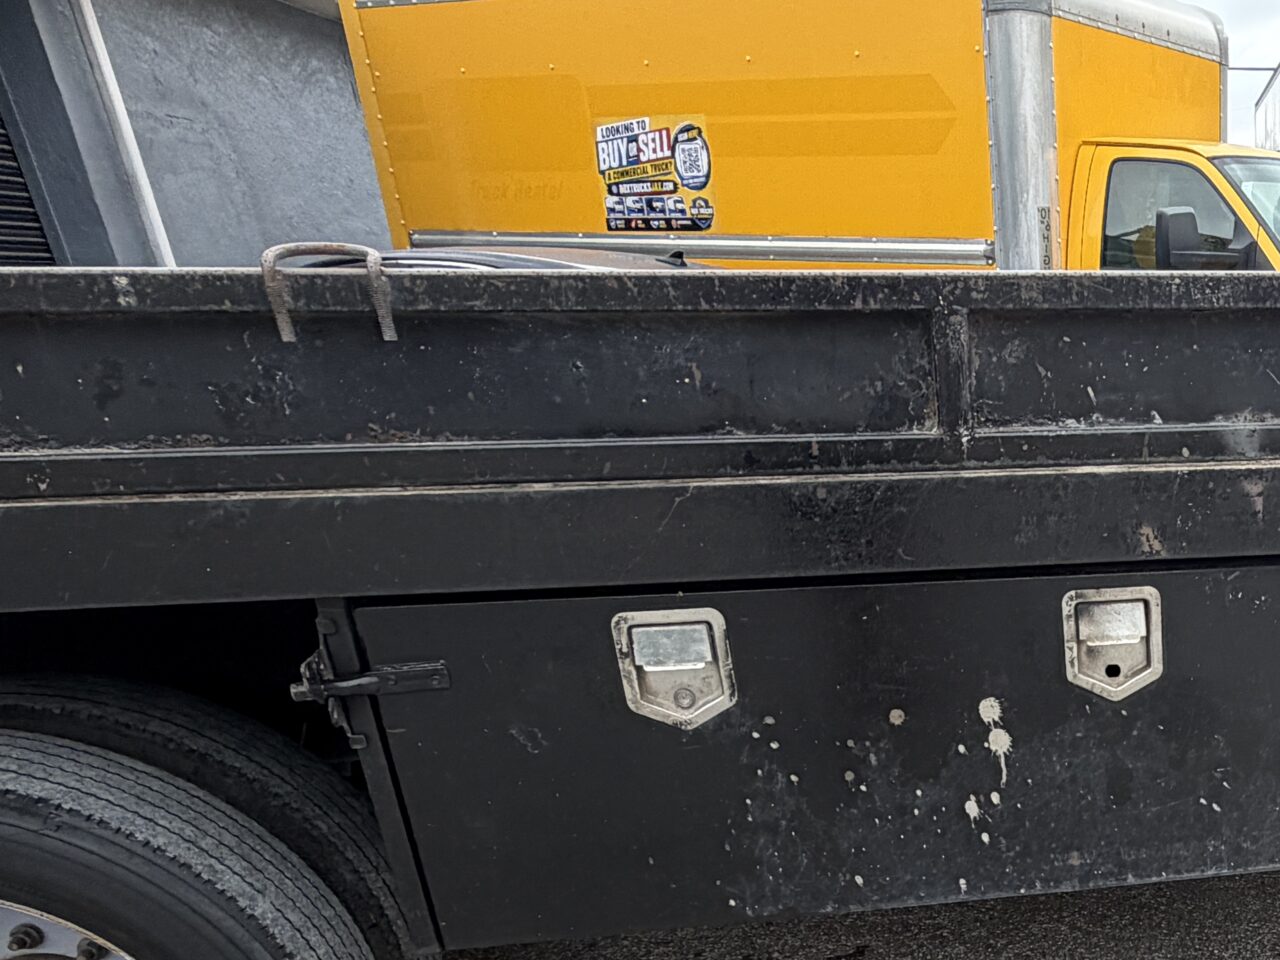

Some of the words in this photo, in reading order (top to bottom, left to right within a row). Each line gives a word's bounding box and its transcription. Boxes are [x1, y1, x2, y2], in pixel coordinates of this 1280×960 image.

[600, 122, 635, 139] LOOKING
[635, 120, 647, 132] TO
[598, 137, 628, 171] BUY
[638, 129, 672, 162] SELL
[613, 166, 649, 179] COMMERCIAL
[650, 161, 673, 174] TRUCK?
